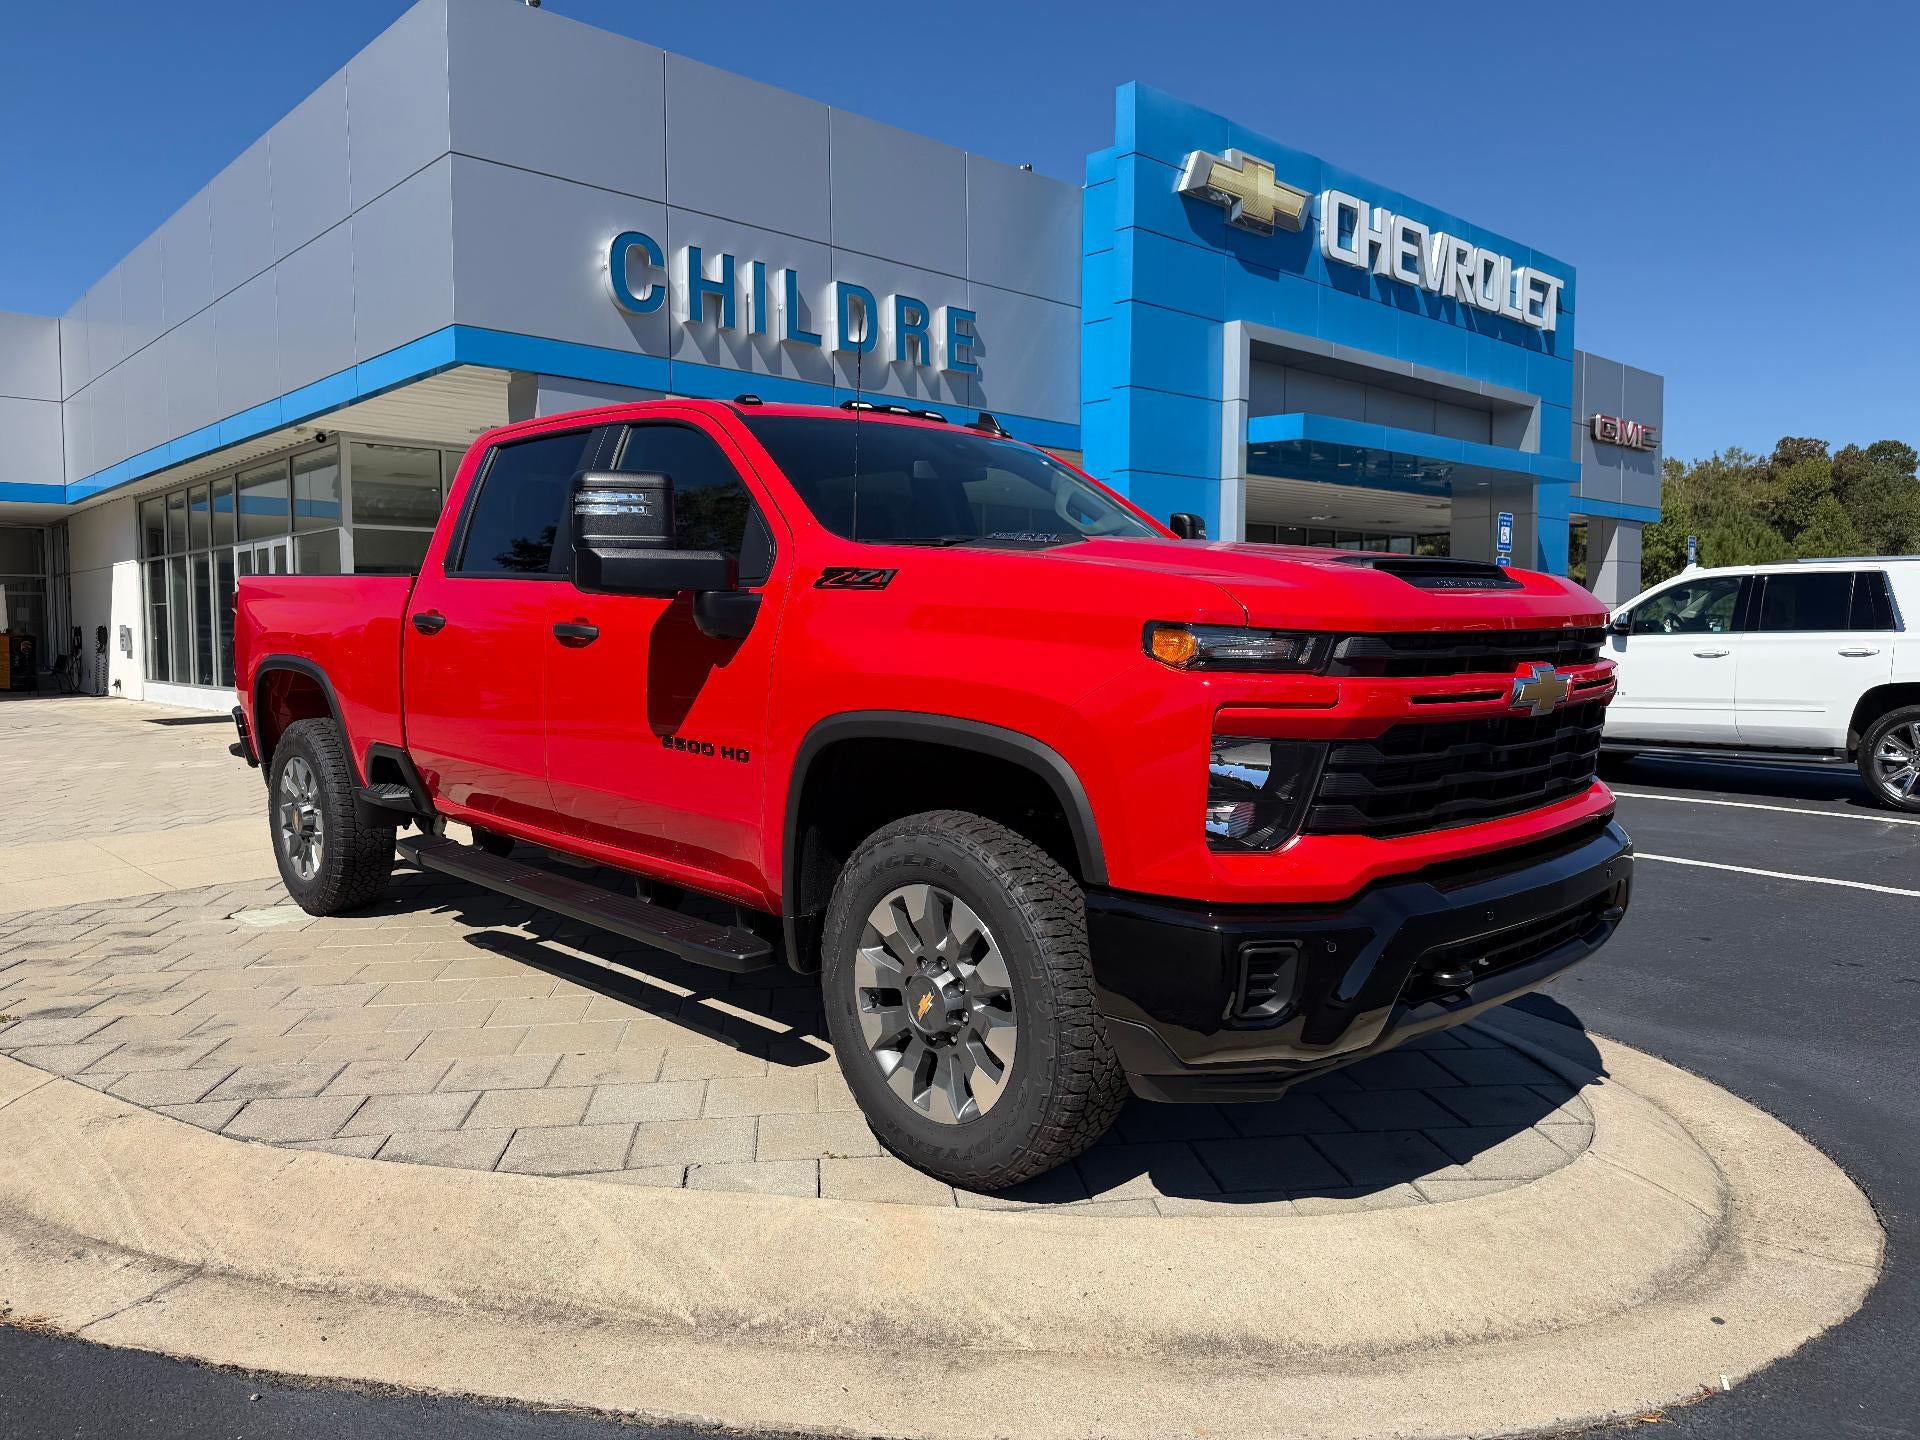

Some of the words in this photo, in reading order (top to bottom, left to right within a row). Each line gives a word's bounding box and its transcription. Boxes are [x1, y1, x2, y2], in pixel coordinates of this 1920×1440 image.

[1320, 189, 1564, 332] CHEVROLET
[602, 231, 979, 374] CHILDRE
[1594, 413, 1658, 451] GMC
[813, 566, 900, 591] Z71
[720, 745, 750, 764] HD
